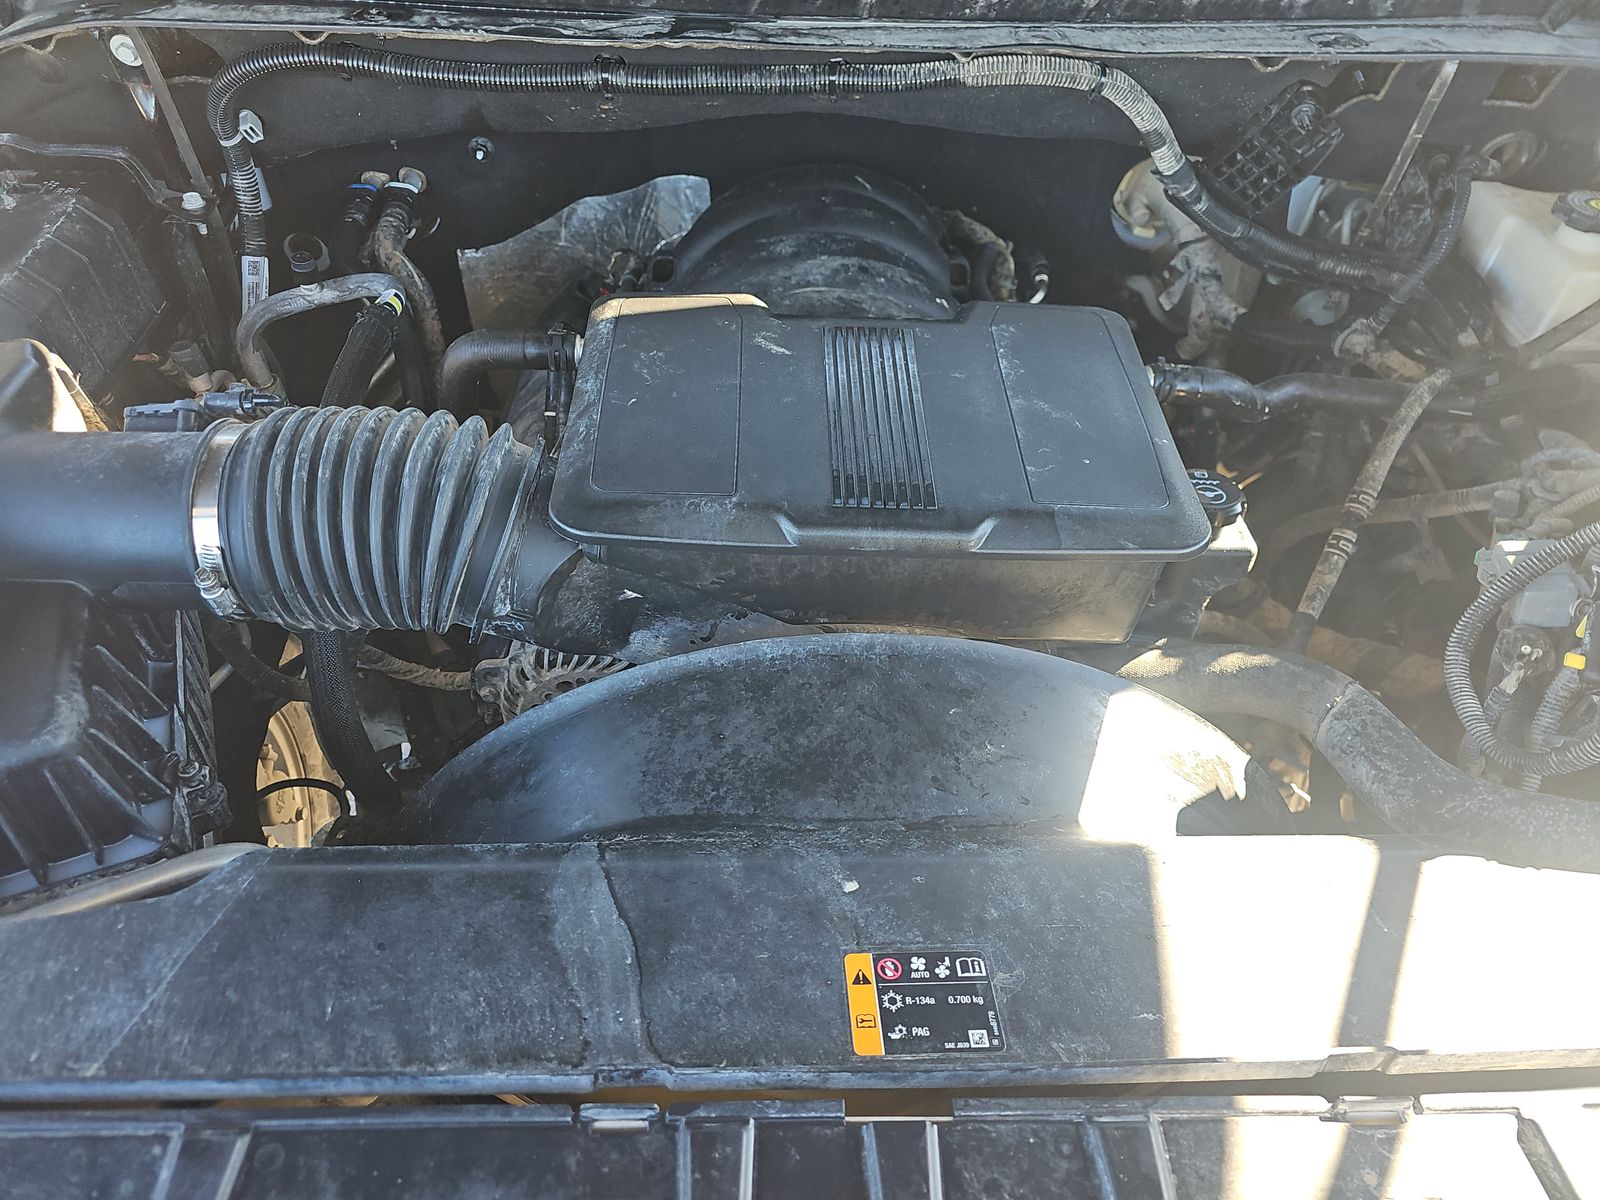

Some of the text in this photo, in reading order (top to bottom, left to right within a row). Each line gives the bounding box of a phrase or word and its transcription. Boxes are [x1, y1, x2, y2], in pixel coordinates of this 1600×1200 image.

[910, 971, 930, 979] AUTO
[905, 995, 984, 1005] R-134a 0.700 kg
[912, 1026, 930, 1036] PAG
